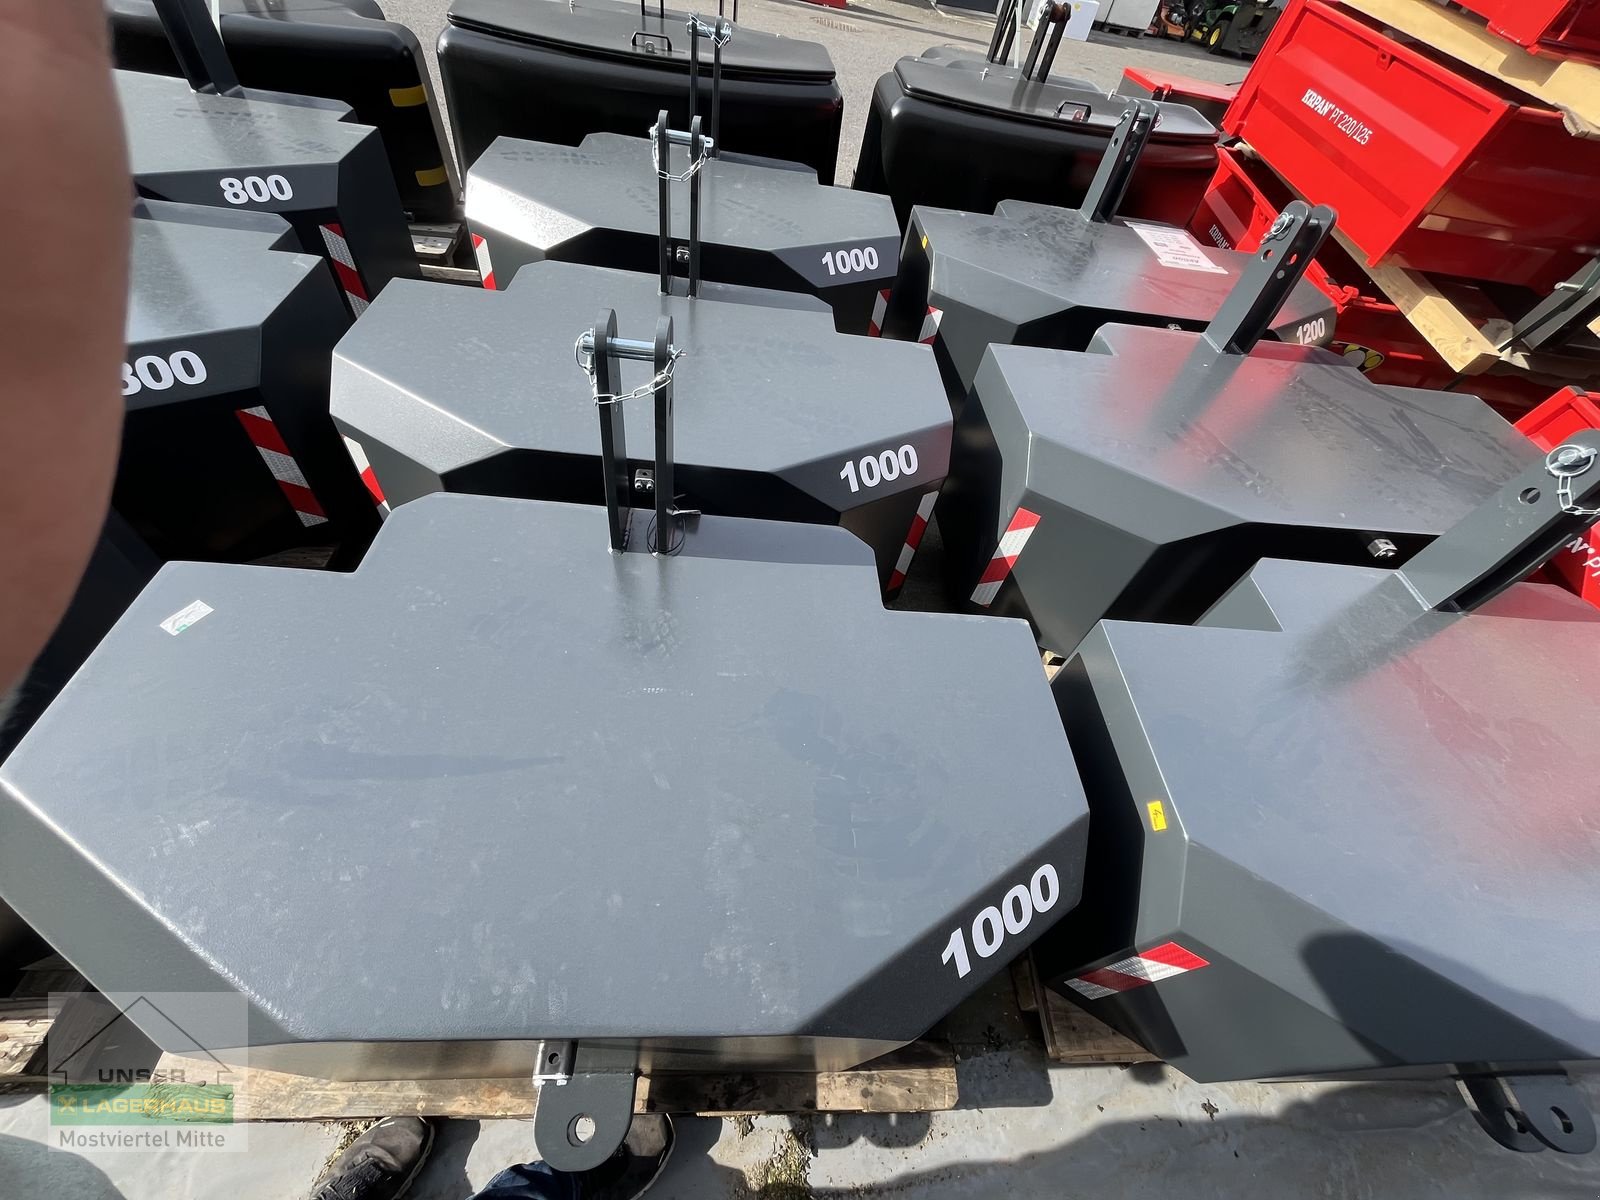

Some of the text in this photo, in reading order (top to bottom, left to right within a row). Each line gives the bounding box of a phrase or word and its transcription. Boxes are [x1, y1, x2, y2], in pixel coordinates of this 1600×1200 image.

[1328, 107, 1345, 124] PT
[1337, 114, 1373, 145] 220/125
[219, 174, 294, 205] 800
[821, 246, 879, 276] 1000
[1296, 317, 1326, 345] 1200
[839, 444, 919, 493] 1000
[941, 863, 1060, 979] 1000
